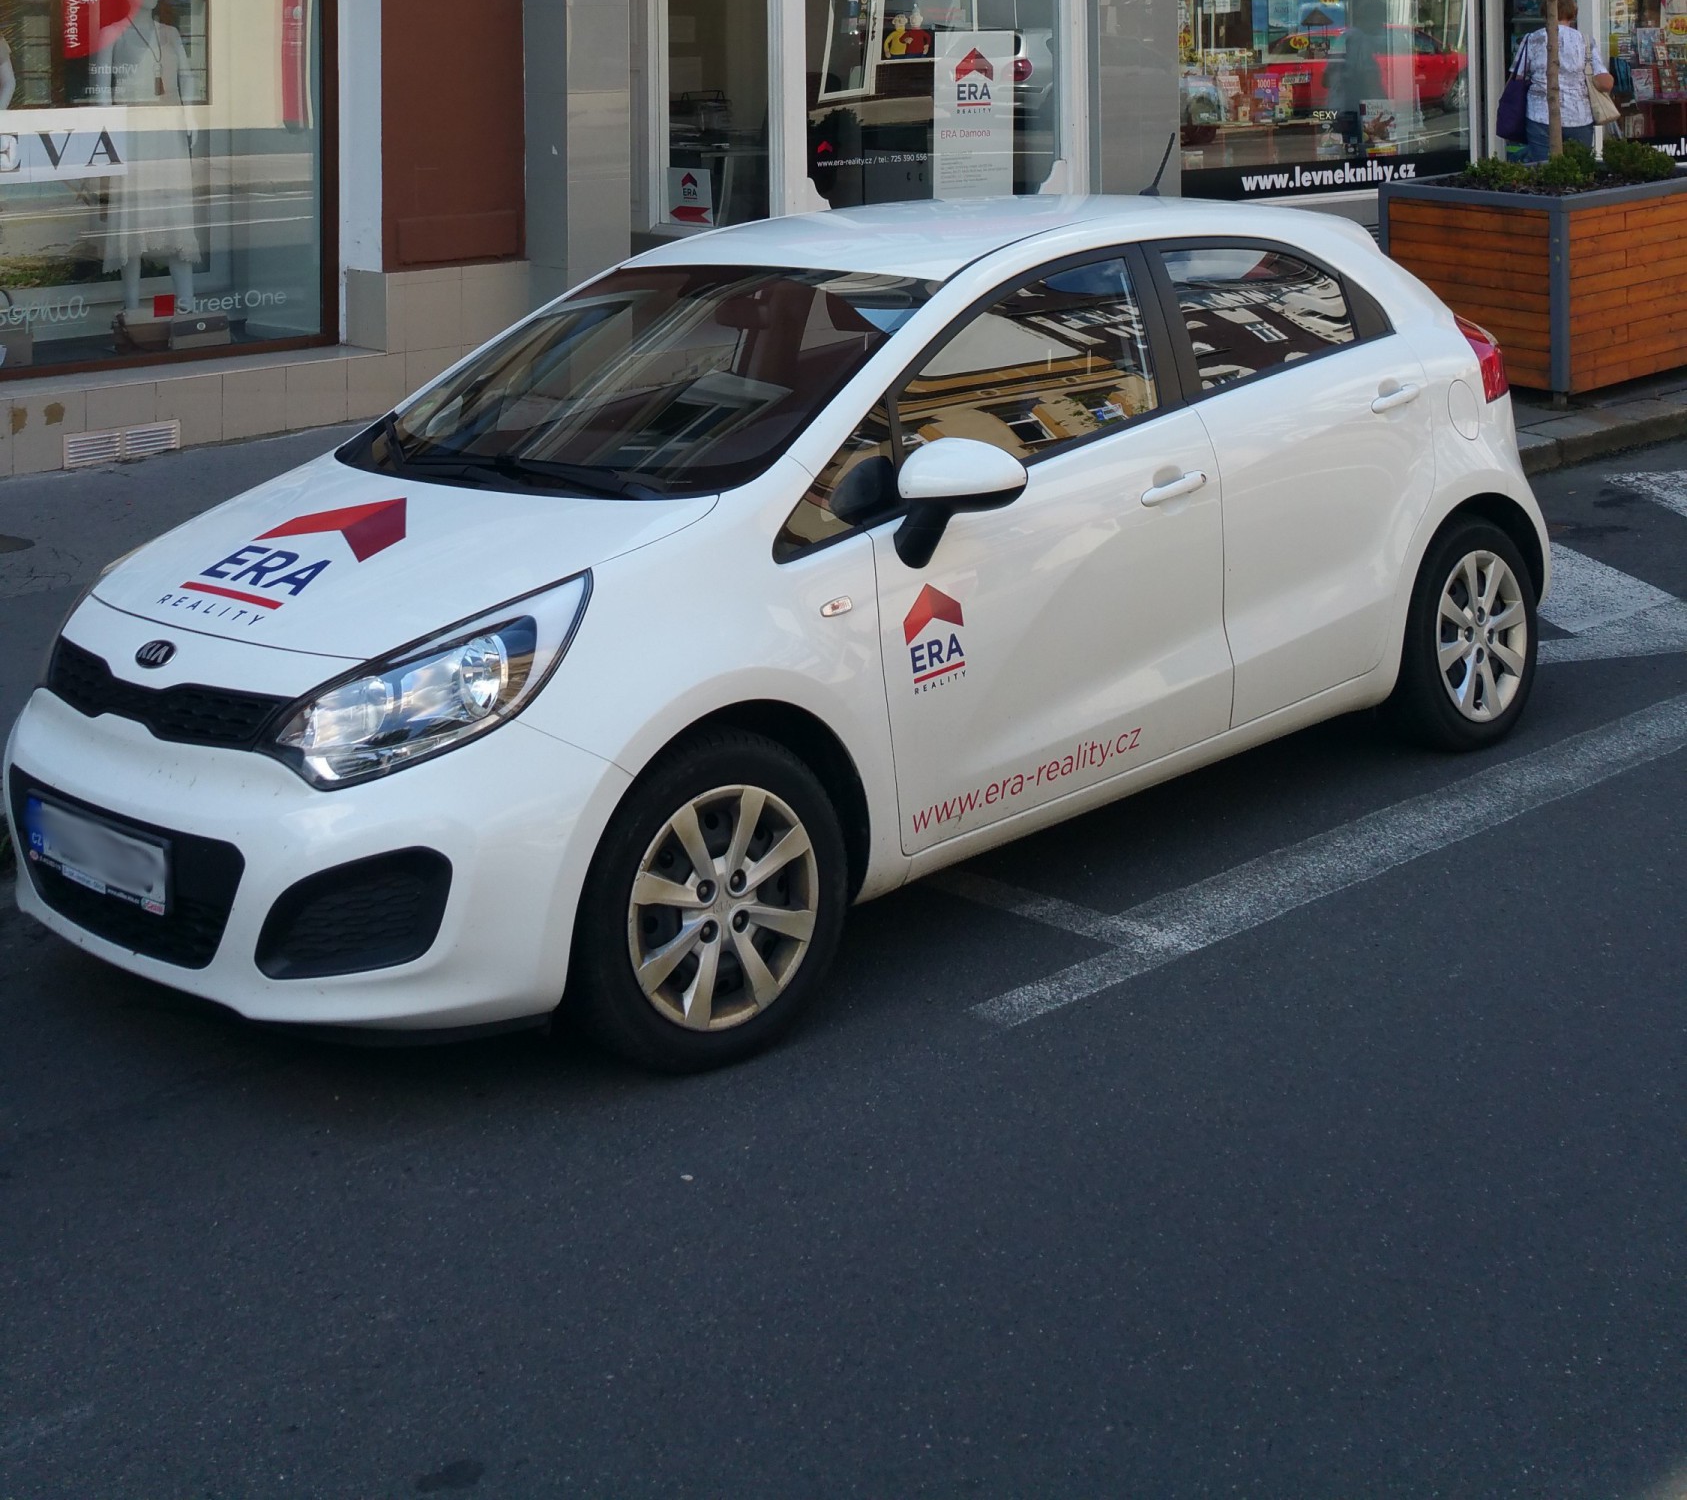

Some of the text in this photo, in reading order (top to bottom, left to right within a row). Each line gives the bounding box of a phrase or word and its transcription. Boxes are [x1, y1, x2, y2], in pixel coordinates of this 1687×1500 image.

[956, 82, 992, 101] ERA
[1313, 110, 1338, 120] SEXY
[940, 129, 991, 140] ERA Damona
[816, 157, 873, 168] www.era-reality.cz
[890, 154, 902, 163] 725
[903, 153, 915, 162] 390
[1241, 159, 1416, 192] www.levneknihy.cz
[682, 188, 698, 197] ERA
[176, 289, 287, 315] Street One
[199, 545, 332, 596] ERA
[156, 594, 265, 626] REALITY
[137, 642, 170, 664] KIA
[910, 633, 965, 674] ERA
[914, 670, 967, 696] REALITY
[911, 726, 1143, 835] www.era-reality.cz
